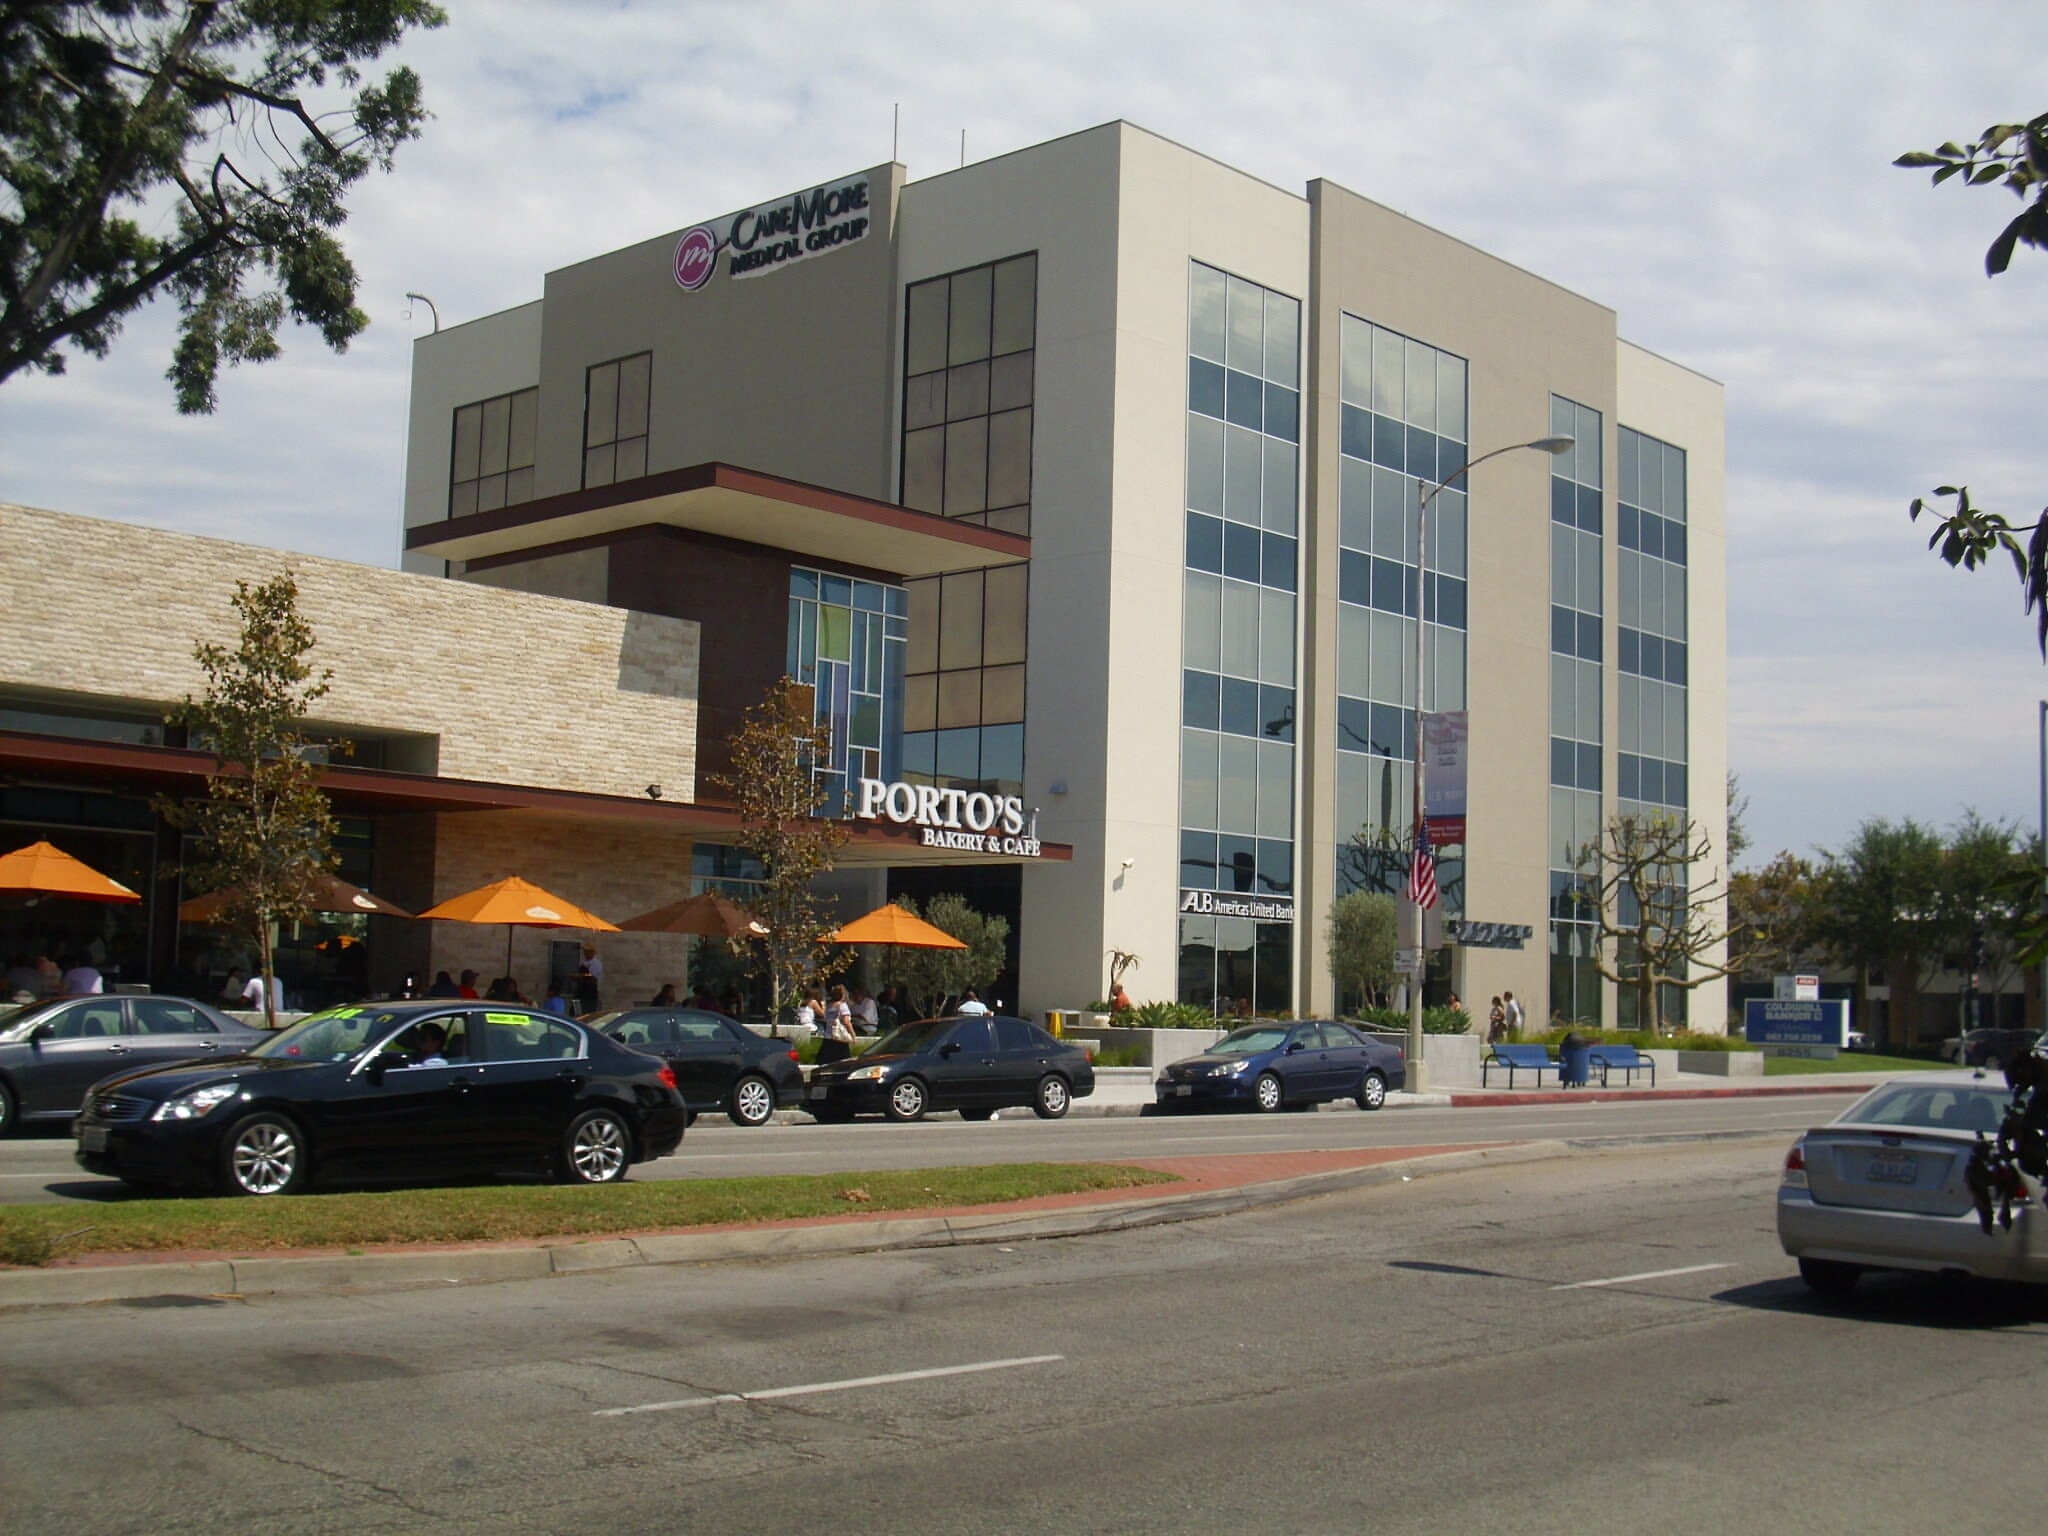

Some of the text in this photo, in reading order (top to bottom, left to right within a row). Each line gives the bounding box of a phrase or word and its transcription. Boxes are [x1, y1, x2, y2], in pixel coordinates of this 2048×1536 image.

[729, 217, 869, 275] MEDICAL GROUP
[857, 777, 1024, 835] PORTO'S
[922, 828, 986, 851] BAKERY
[988, 835, 1001, 852] &
[1215, 899, 1249, 916] Americas
[1250, 902, 1275, 917] United
[1276, 903, 1295, 919] Bank
